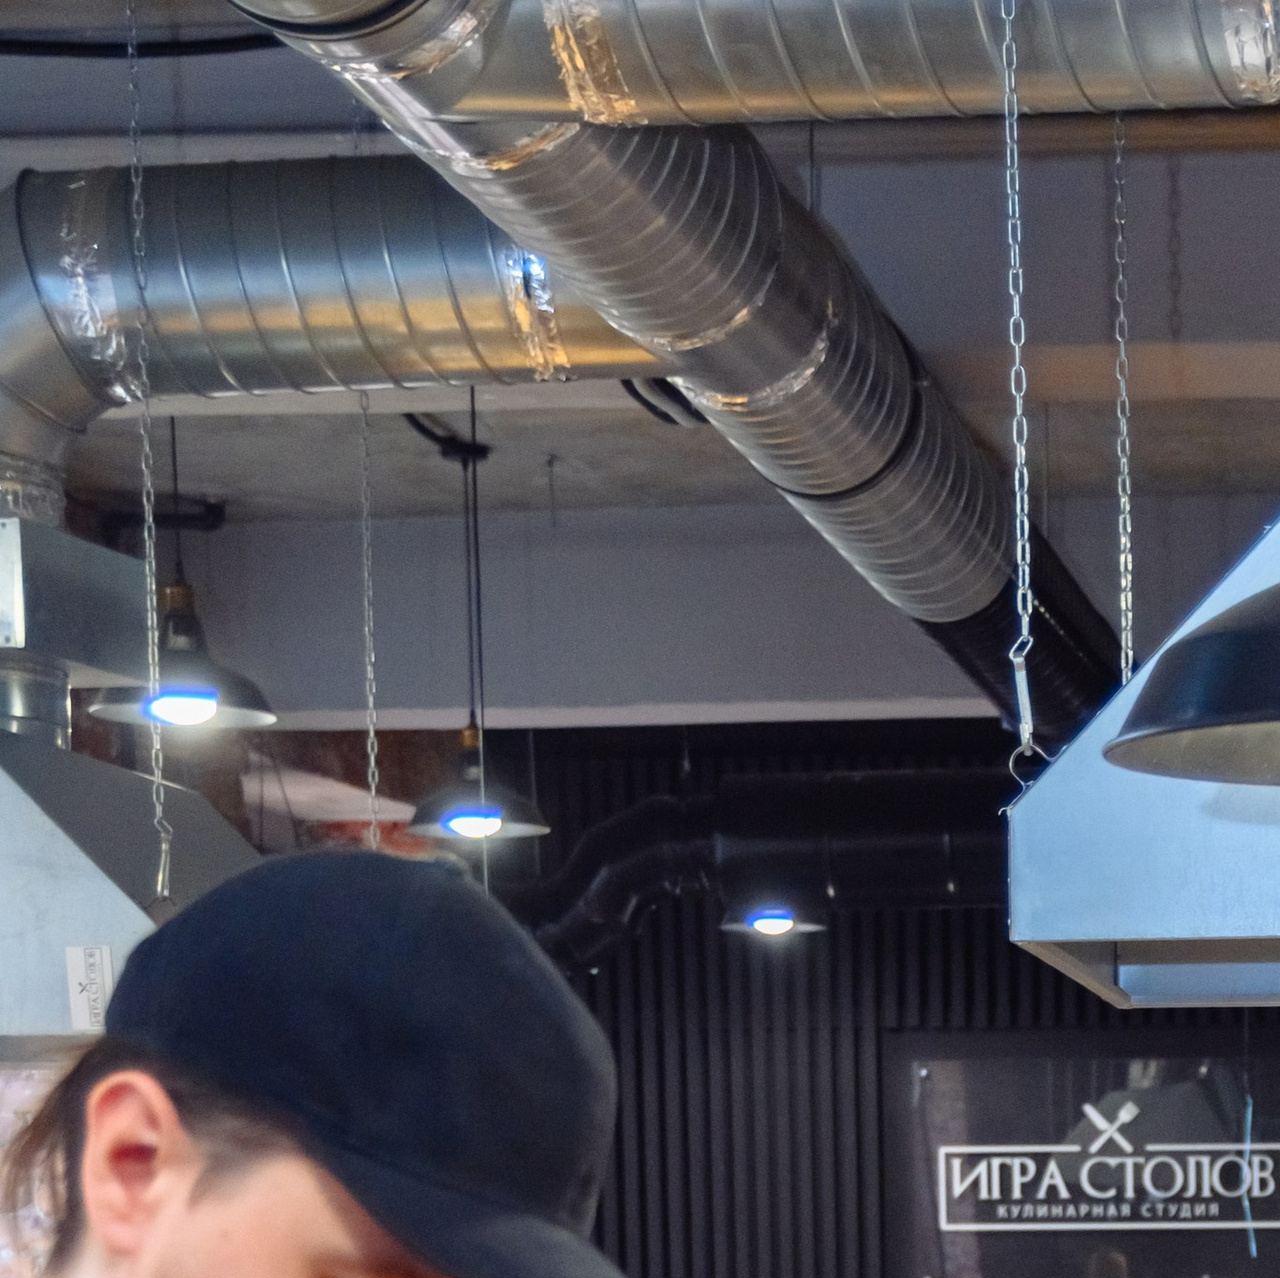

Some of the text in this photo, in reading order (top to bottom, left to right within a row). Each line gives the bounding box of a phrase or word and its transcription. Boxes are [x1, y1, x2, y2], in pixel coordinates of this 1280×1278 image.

[951, 1154, 1276, 1200] ИГРА СТОЛОВ
[996, 1202, 1220, 1219] КУЛИНАРНАЯ СТУДИЯ
